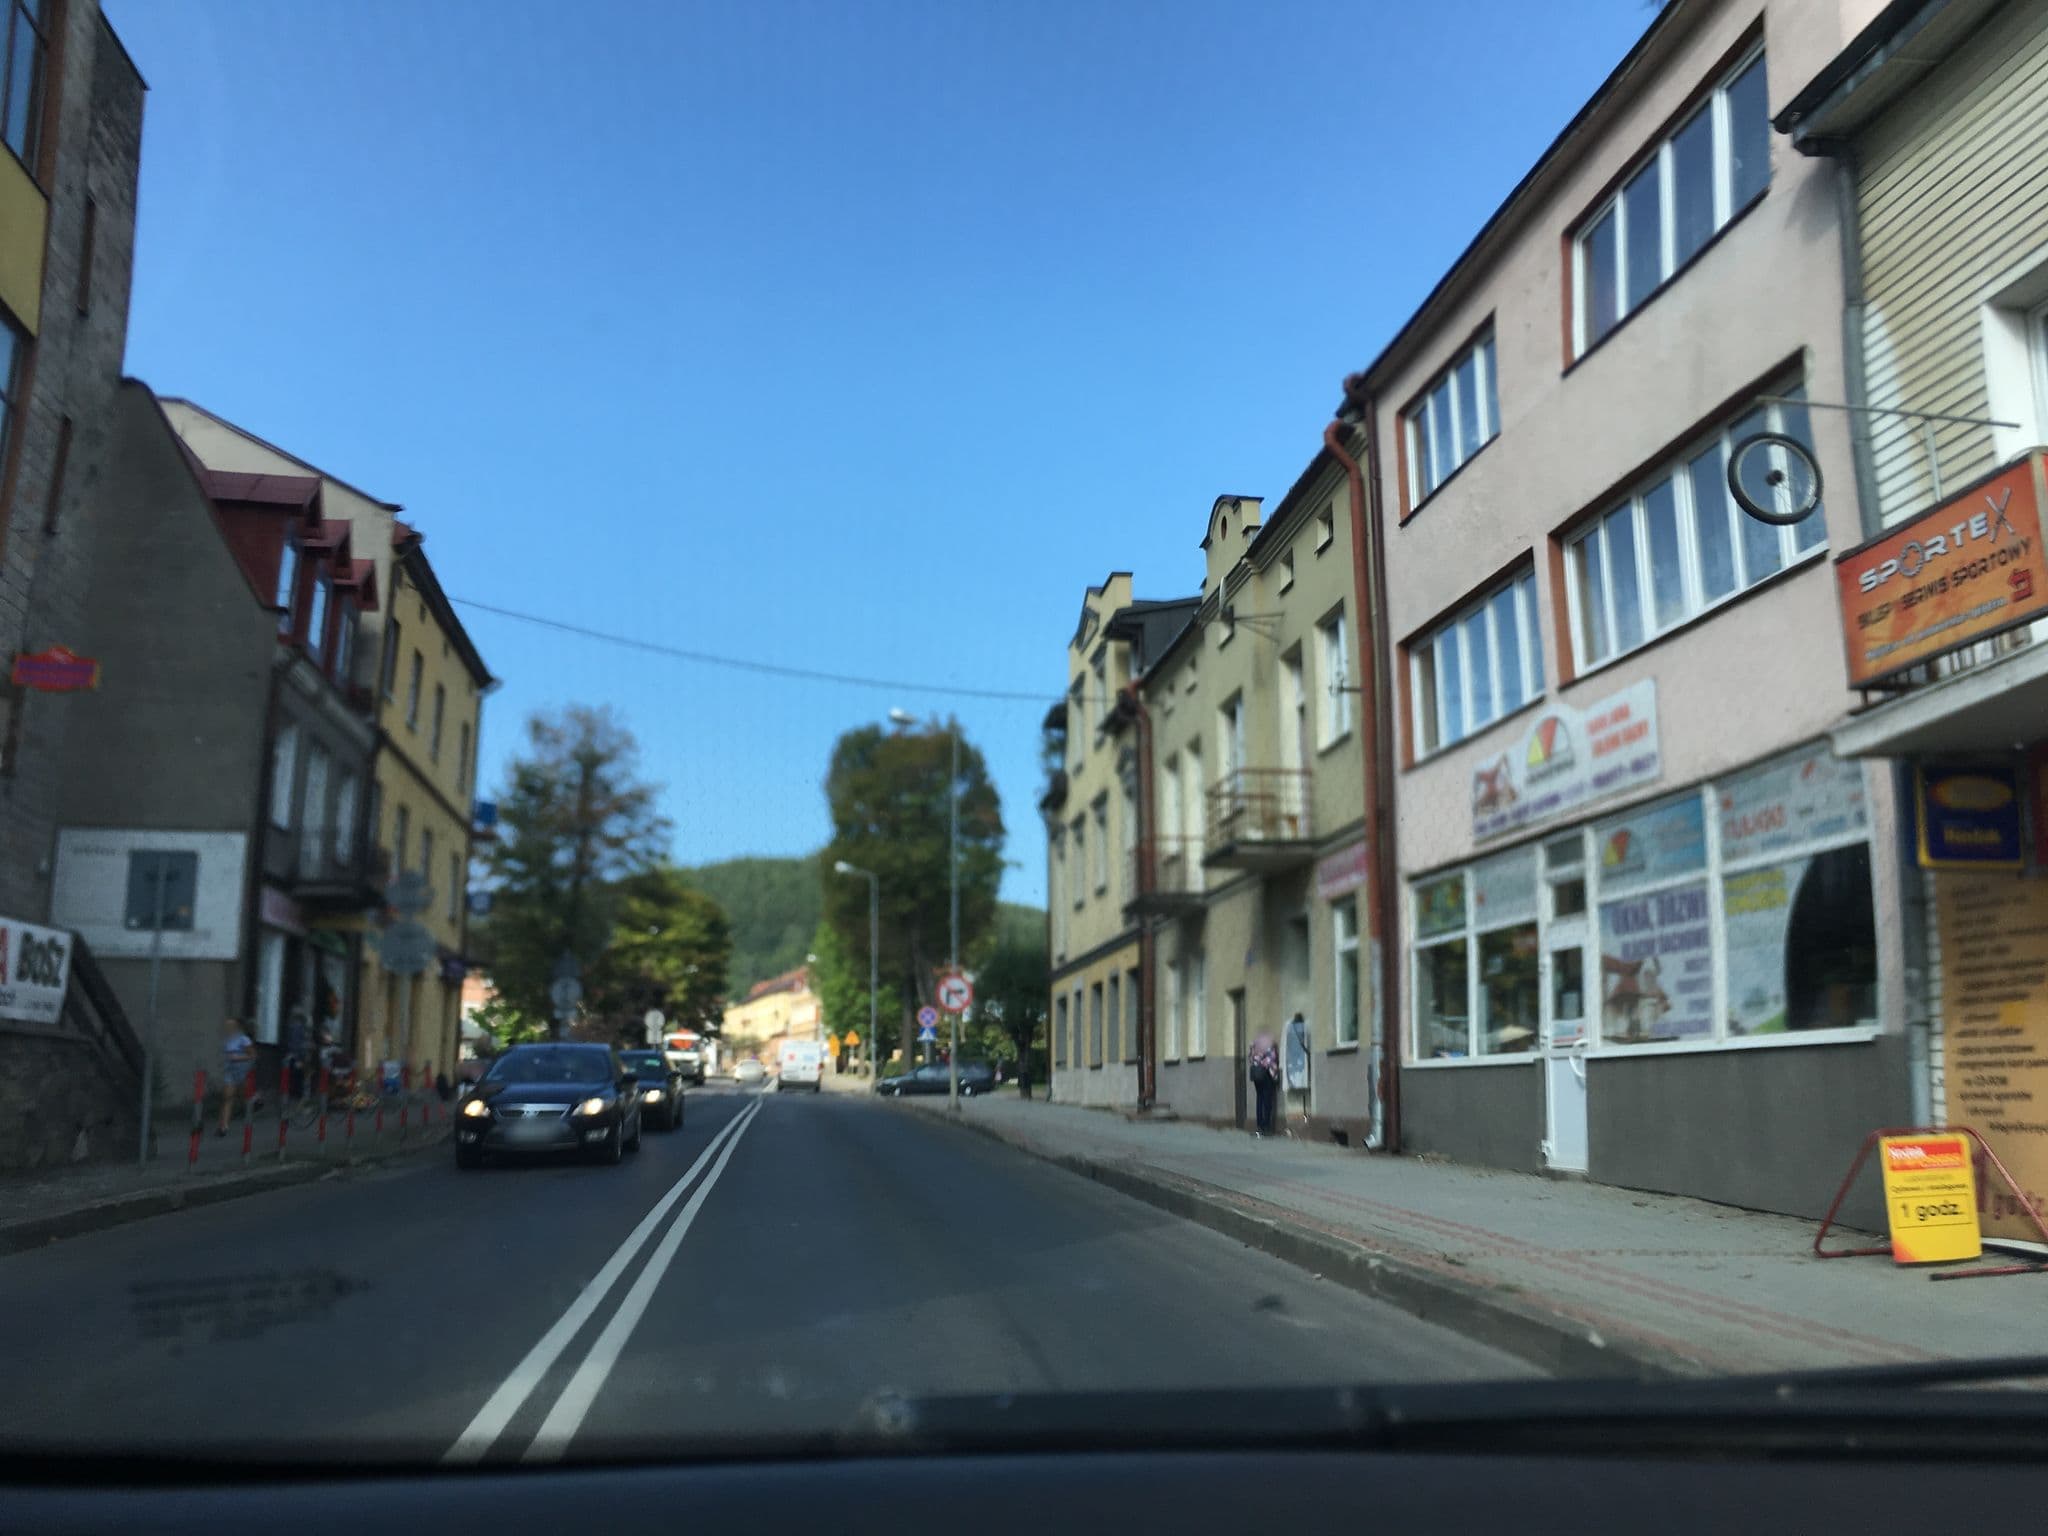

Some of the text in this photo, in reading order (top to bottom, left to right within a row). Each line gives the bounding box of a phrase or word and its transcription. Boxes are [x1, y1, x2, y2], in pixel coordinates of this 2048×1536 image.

[1858, 487, 2015, 593] SPORTEX
[1952, 536, 2031, 588] SPORTOWY
[1901, 1203, 1909, 1218] 1
